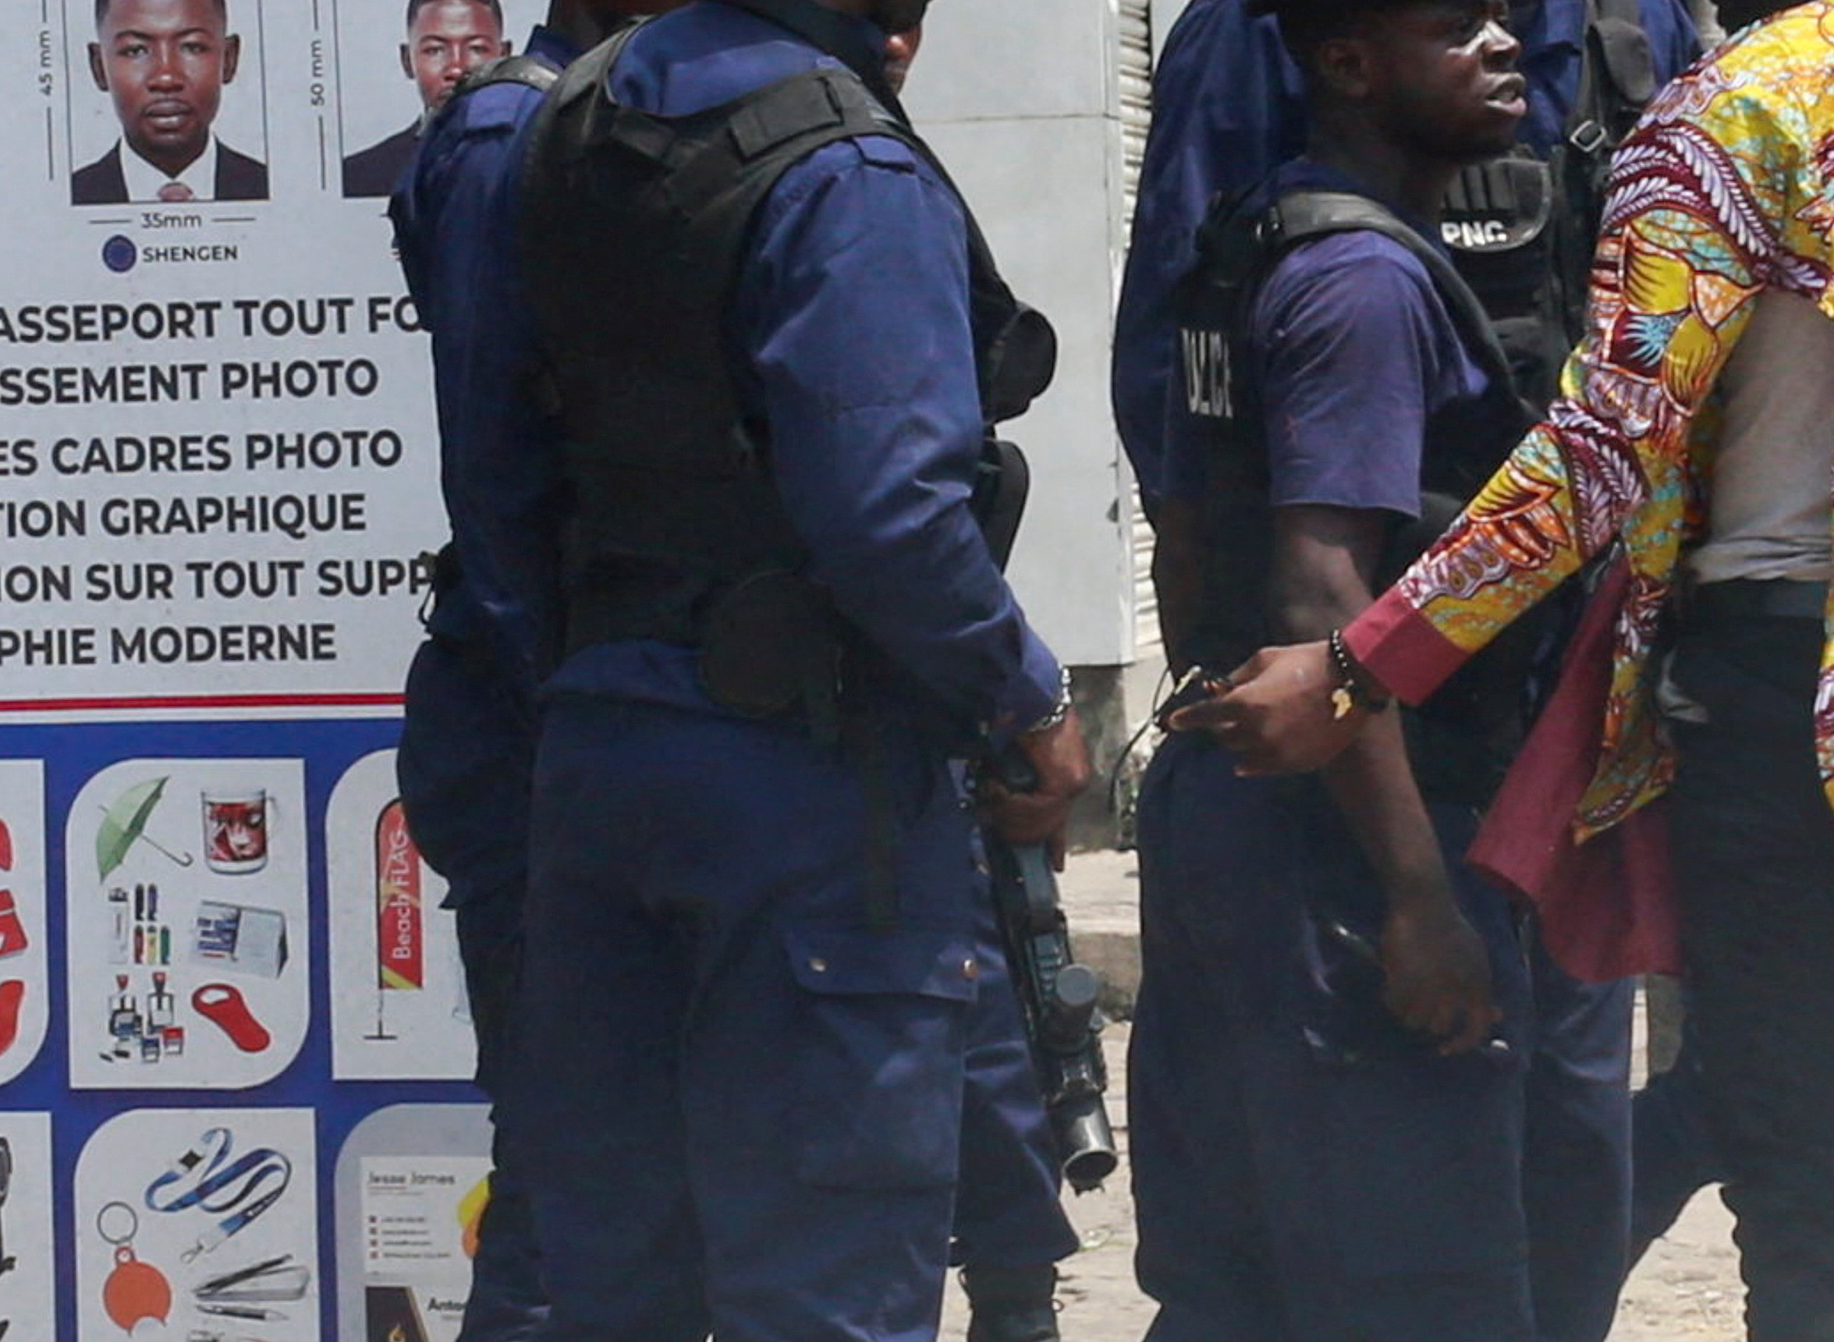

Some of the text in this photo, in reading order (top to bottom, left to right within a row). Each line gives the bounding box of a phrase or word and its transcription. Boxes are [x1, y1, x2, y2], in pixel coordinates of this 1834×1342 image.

[38, 30, 53, 97] 45 mm
[310, 39, 325, 107] 50 mm
[141, 212, 202, 229] 35mm
[142, 245, 239, 263] SHENGEN
[233, 296, 354, 337] TOUT
[222, 358, 379, 401] PHOTO
[51, 434, 232, 476] CADRES
[246, 429, 403, 471] PHOTO
[101, 493, 367, 540] GRAPHIQUE
[86, 563, 173, 603] SUR
[180, 559, 305, 600] TOUT
[110, 623, 336, 665] MODERNE
[389, 892, 411, 959] Beach
